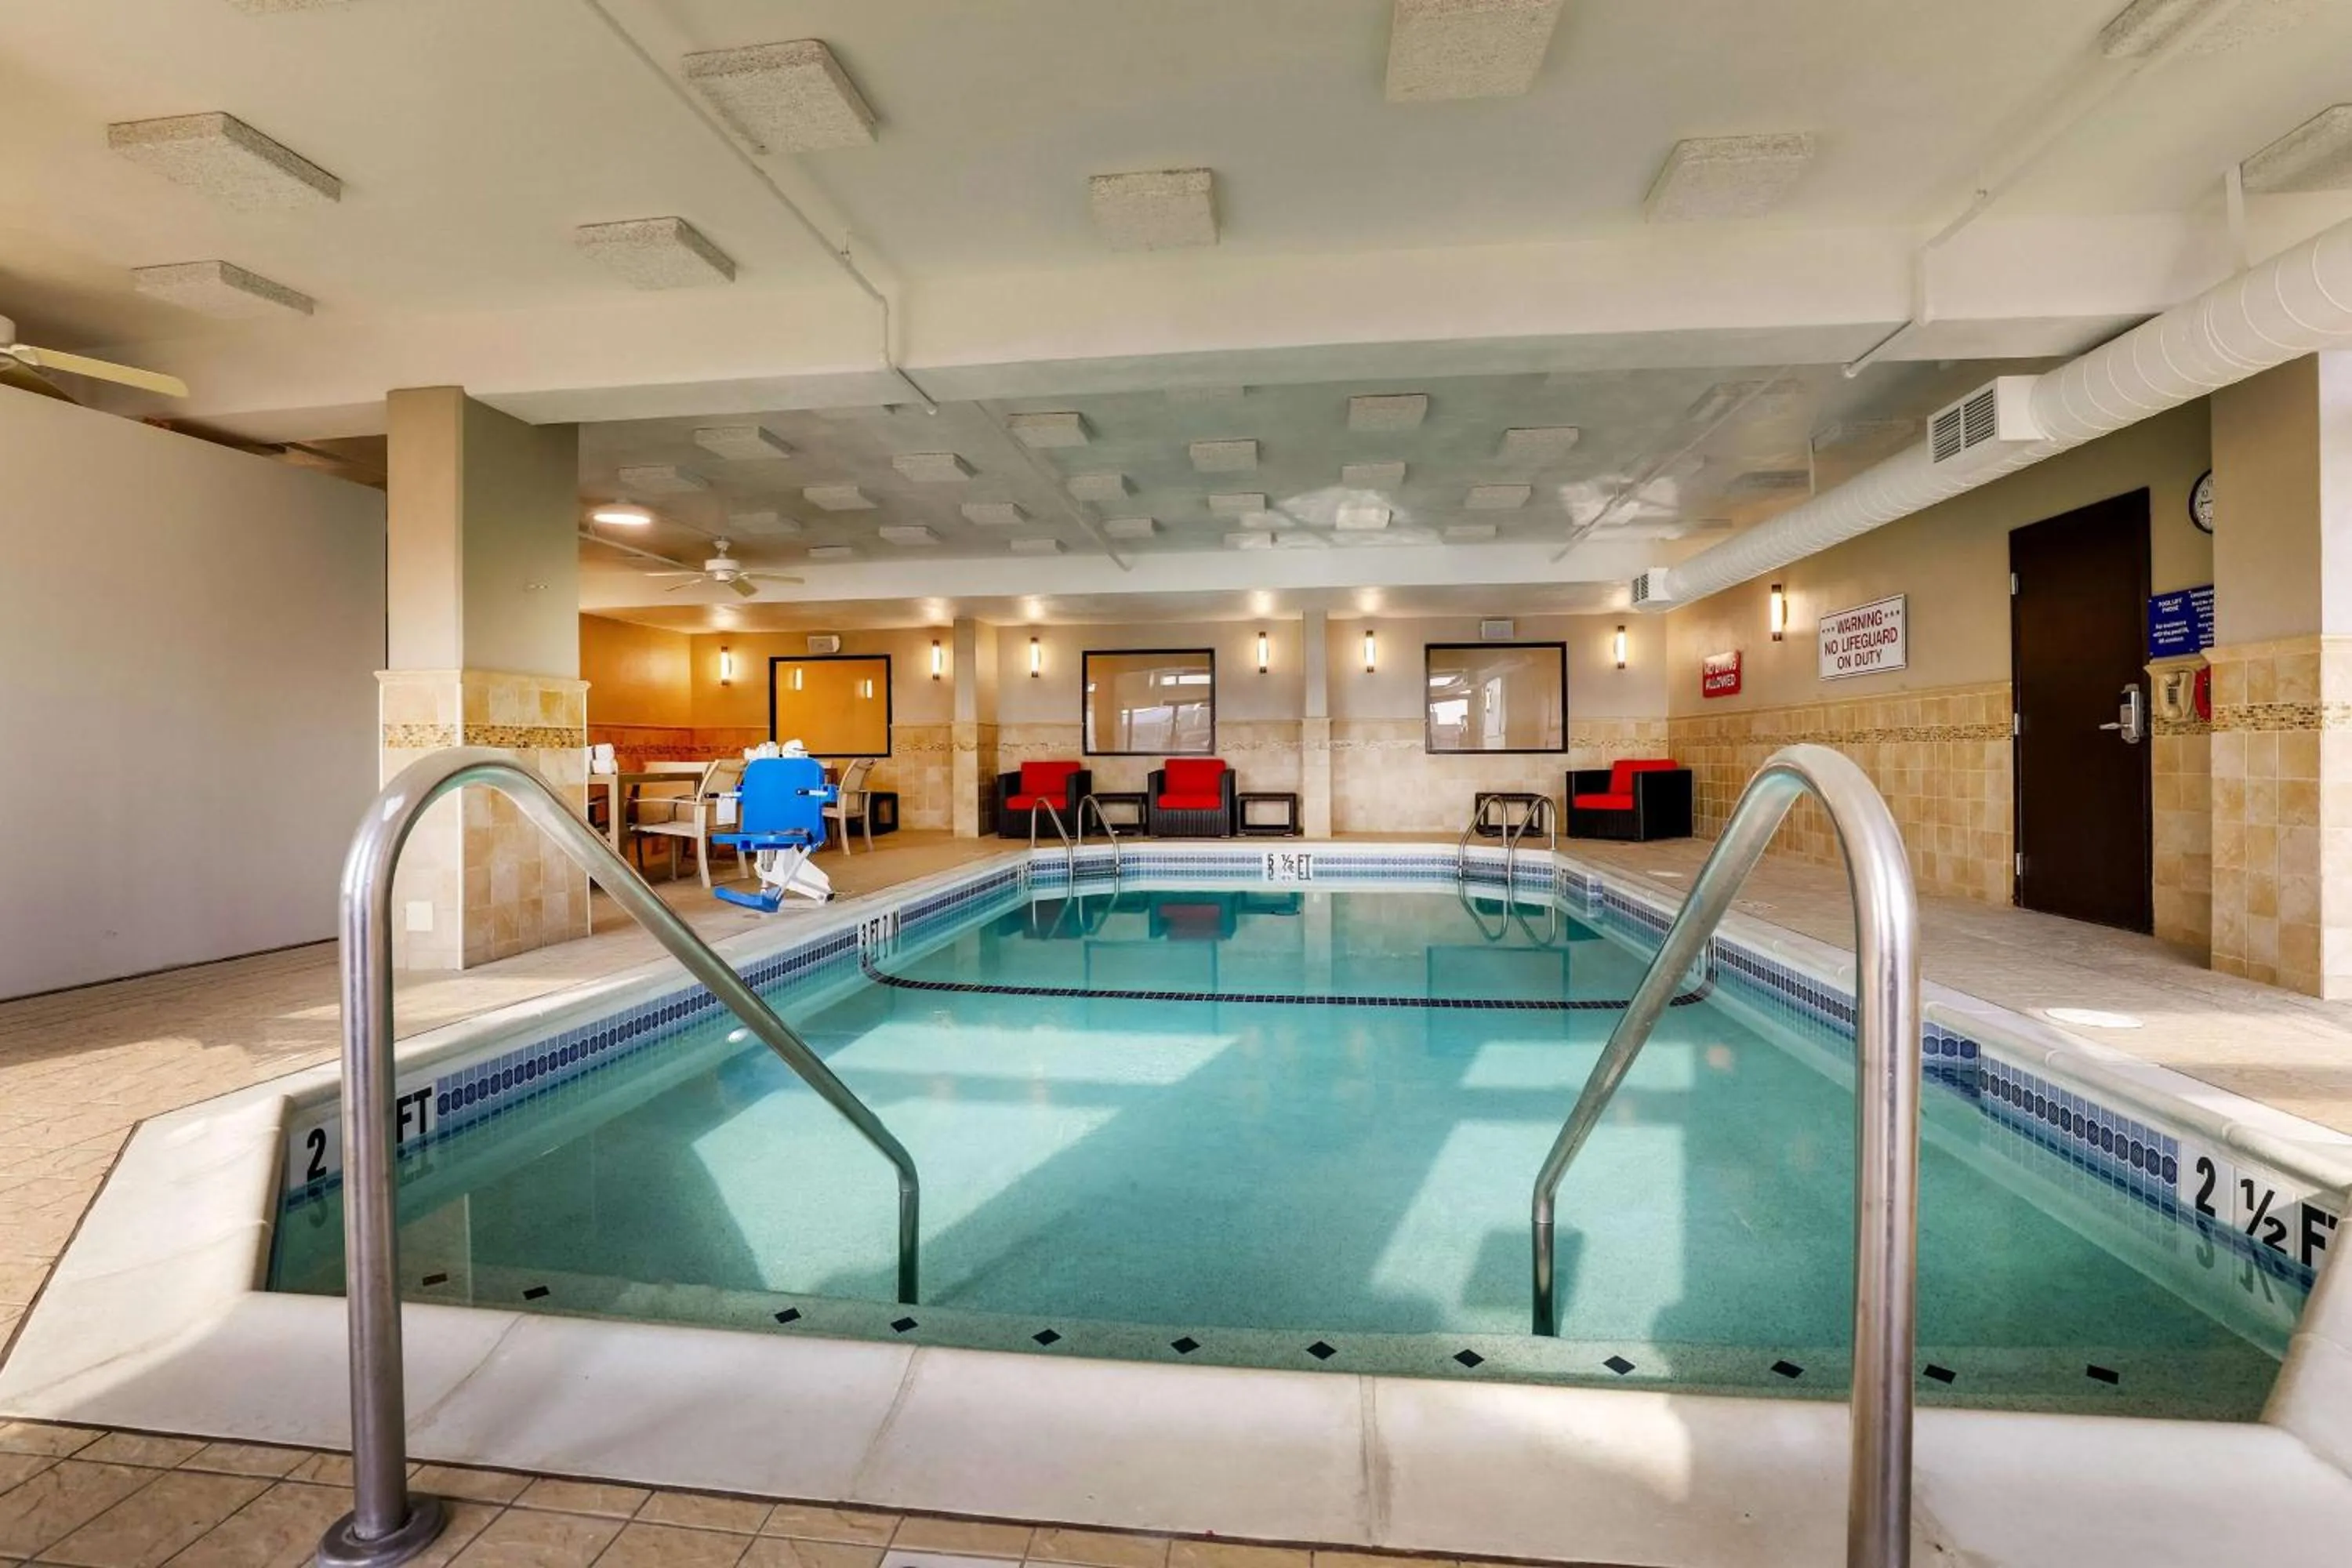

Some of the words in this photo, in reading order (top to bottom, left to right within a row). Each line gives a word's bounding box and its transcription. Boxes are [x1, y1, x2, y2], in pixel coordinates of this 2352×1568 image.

[1837, 610, 1882, 633] WARNING
[1824, 640, 1838, 656] NO
[1842, 627, 1898, 652] LIFEGUARD
[1837, 655, 1851, 670] ON
[1855, 648, 1882, 666] DUTY
[307, 1127, 327, 1181] 2
[396, 1087, 432, 1144] FT
[2196, 1156, 2216, 1218] 2
